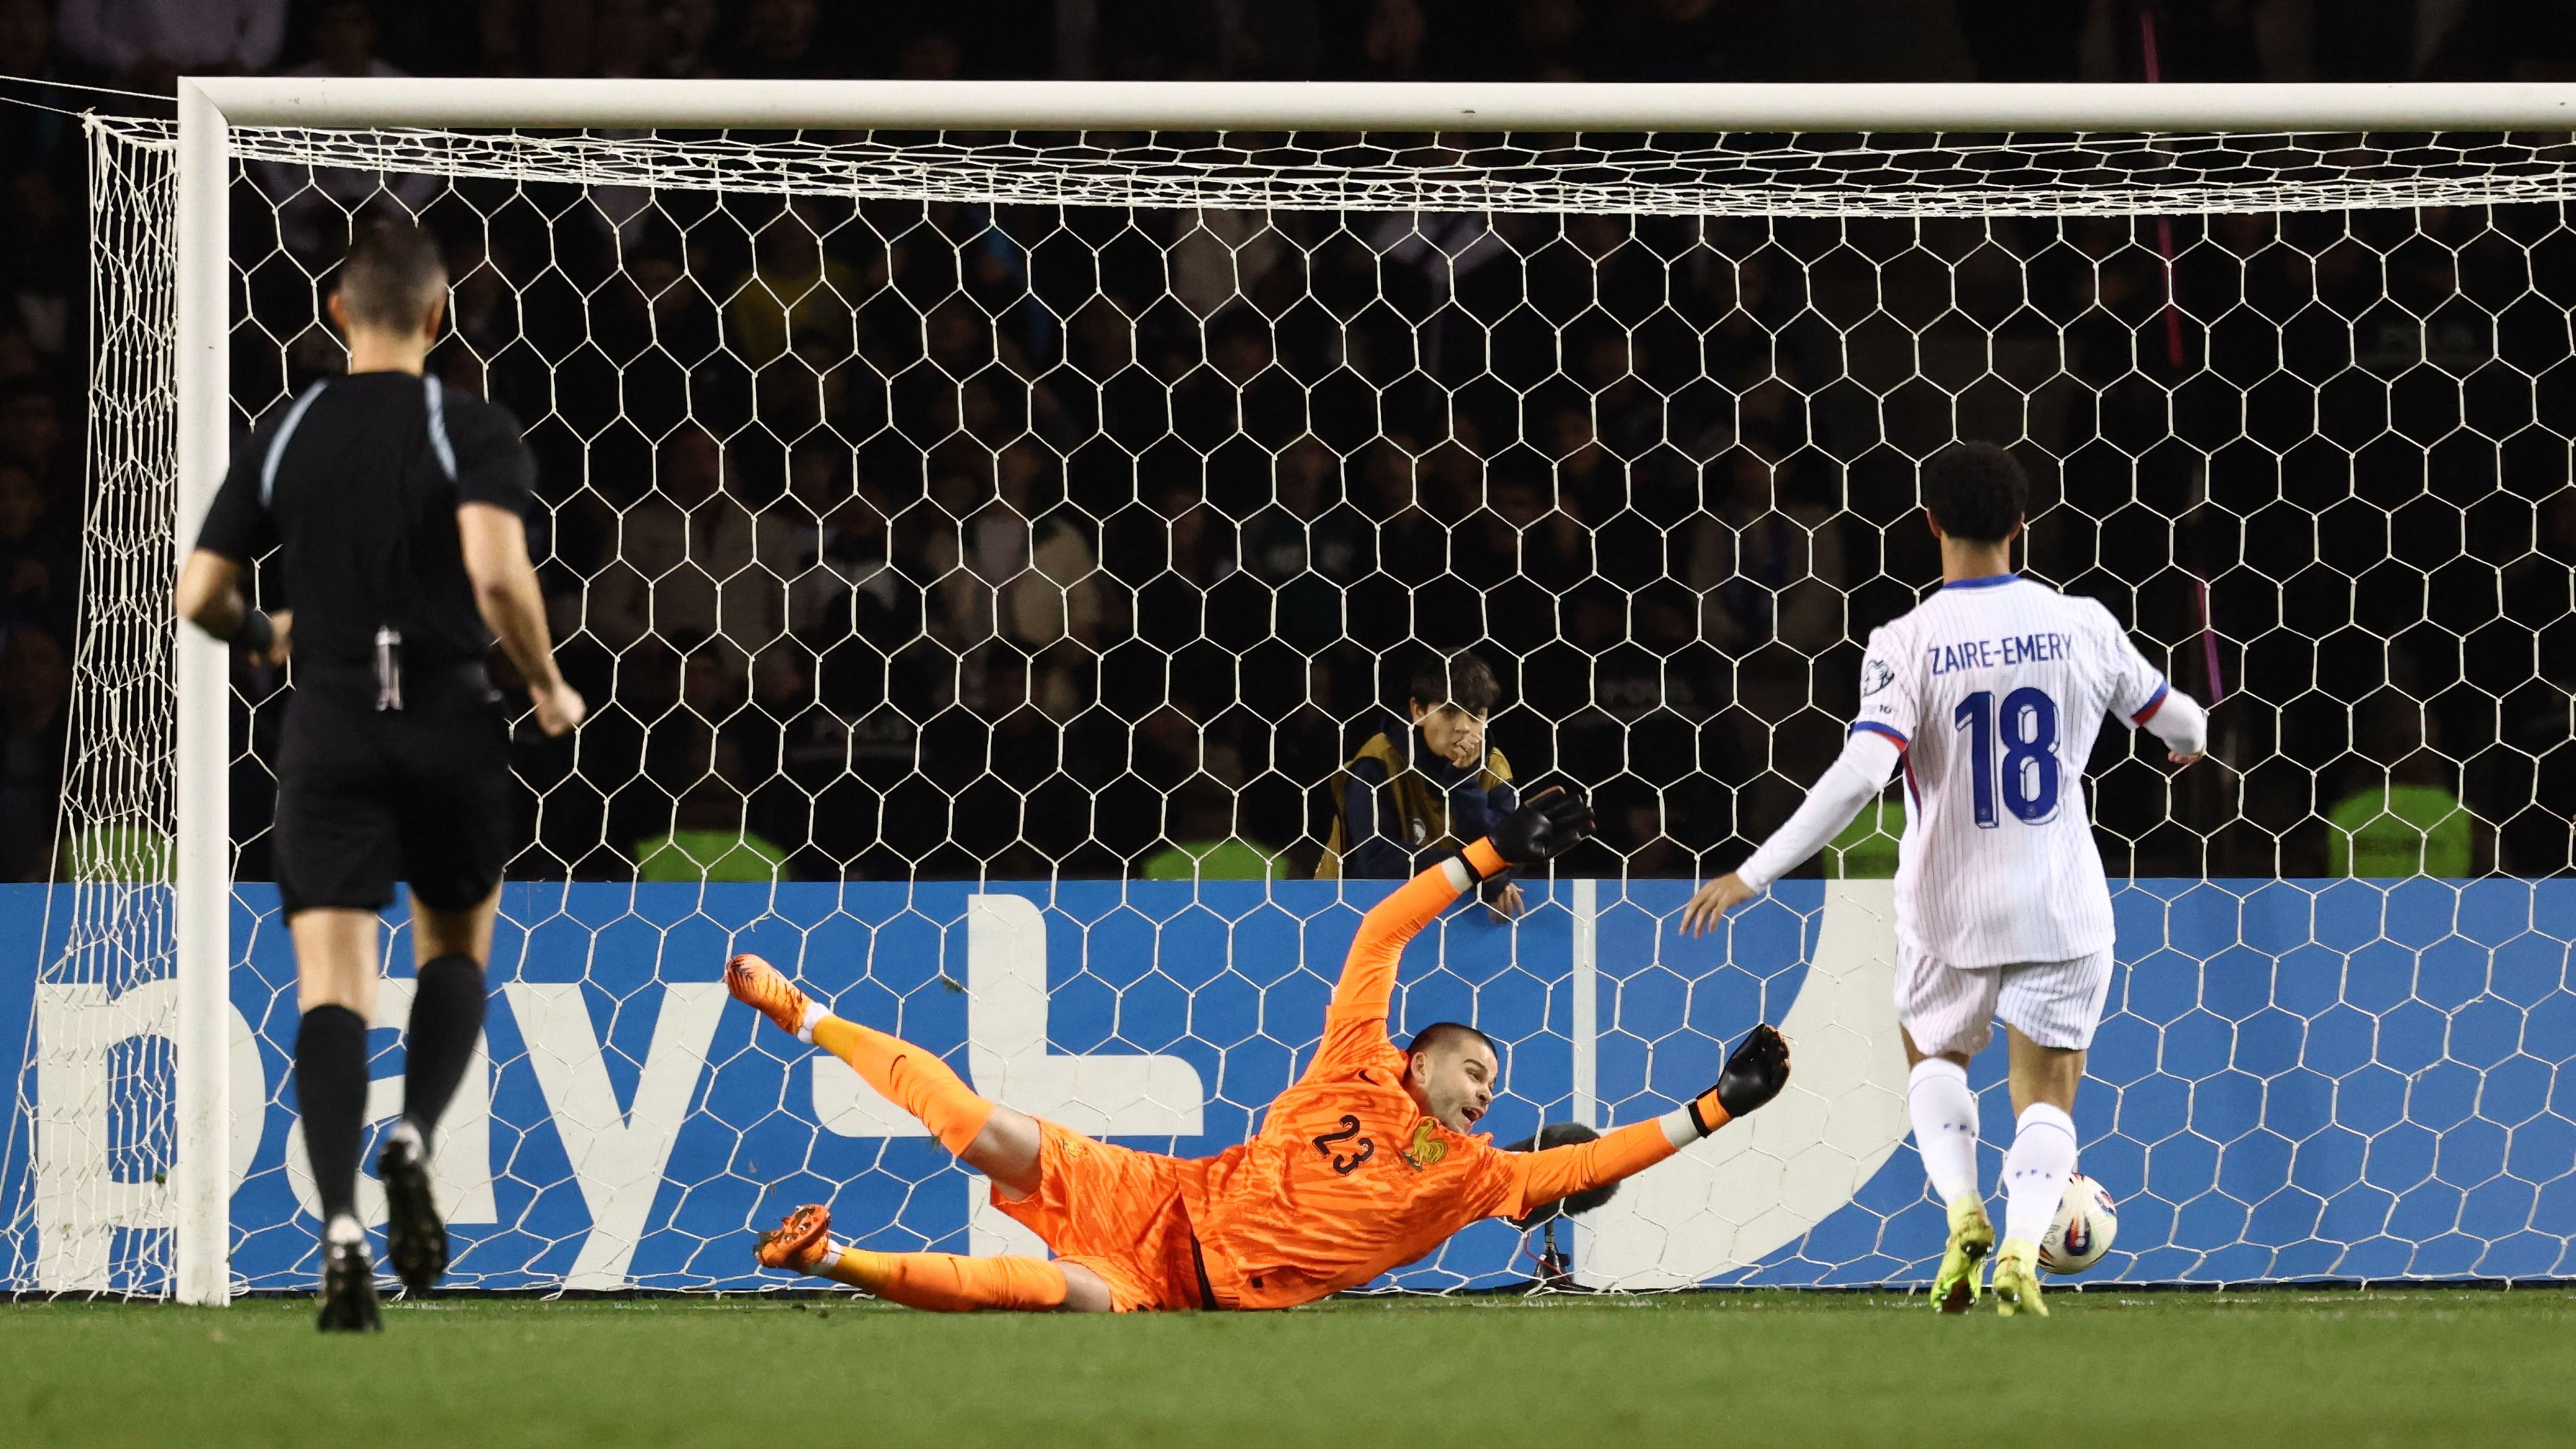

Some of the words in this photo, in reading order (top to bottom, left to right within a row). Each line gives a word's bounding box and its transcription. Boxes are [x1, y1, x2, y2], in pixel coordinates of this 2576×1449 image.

[1928, 633, 2072, 675] ZAIRE-EMERY
[1955, 687, 2060, 829] 18
[1312, 1114, 1374, 1177] 23
